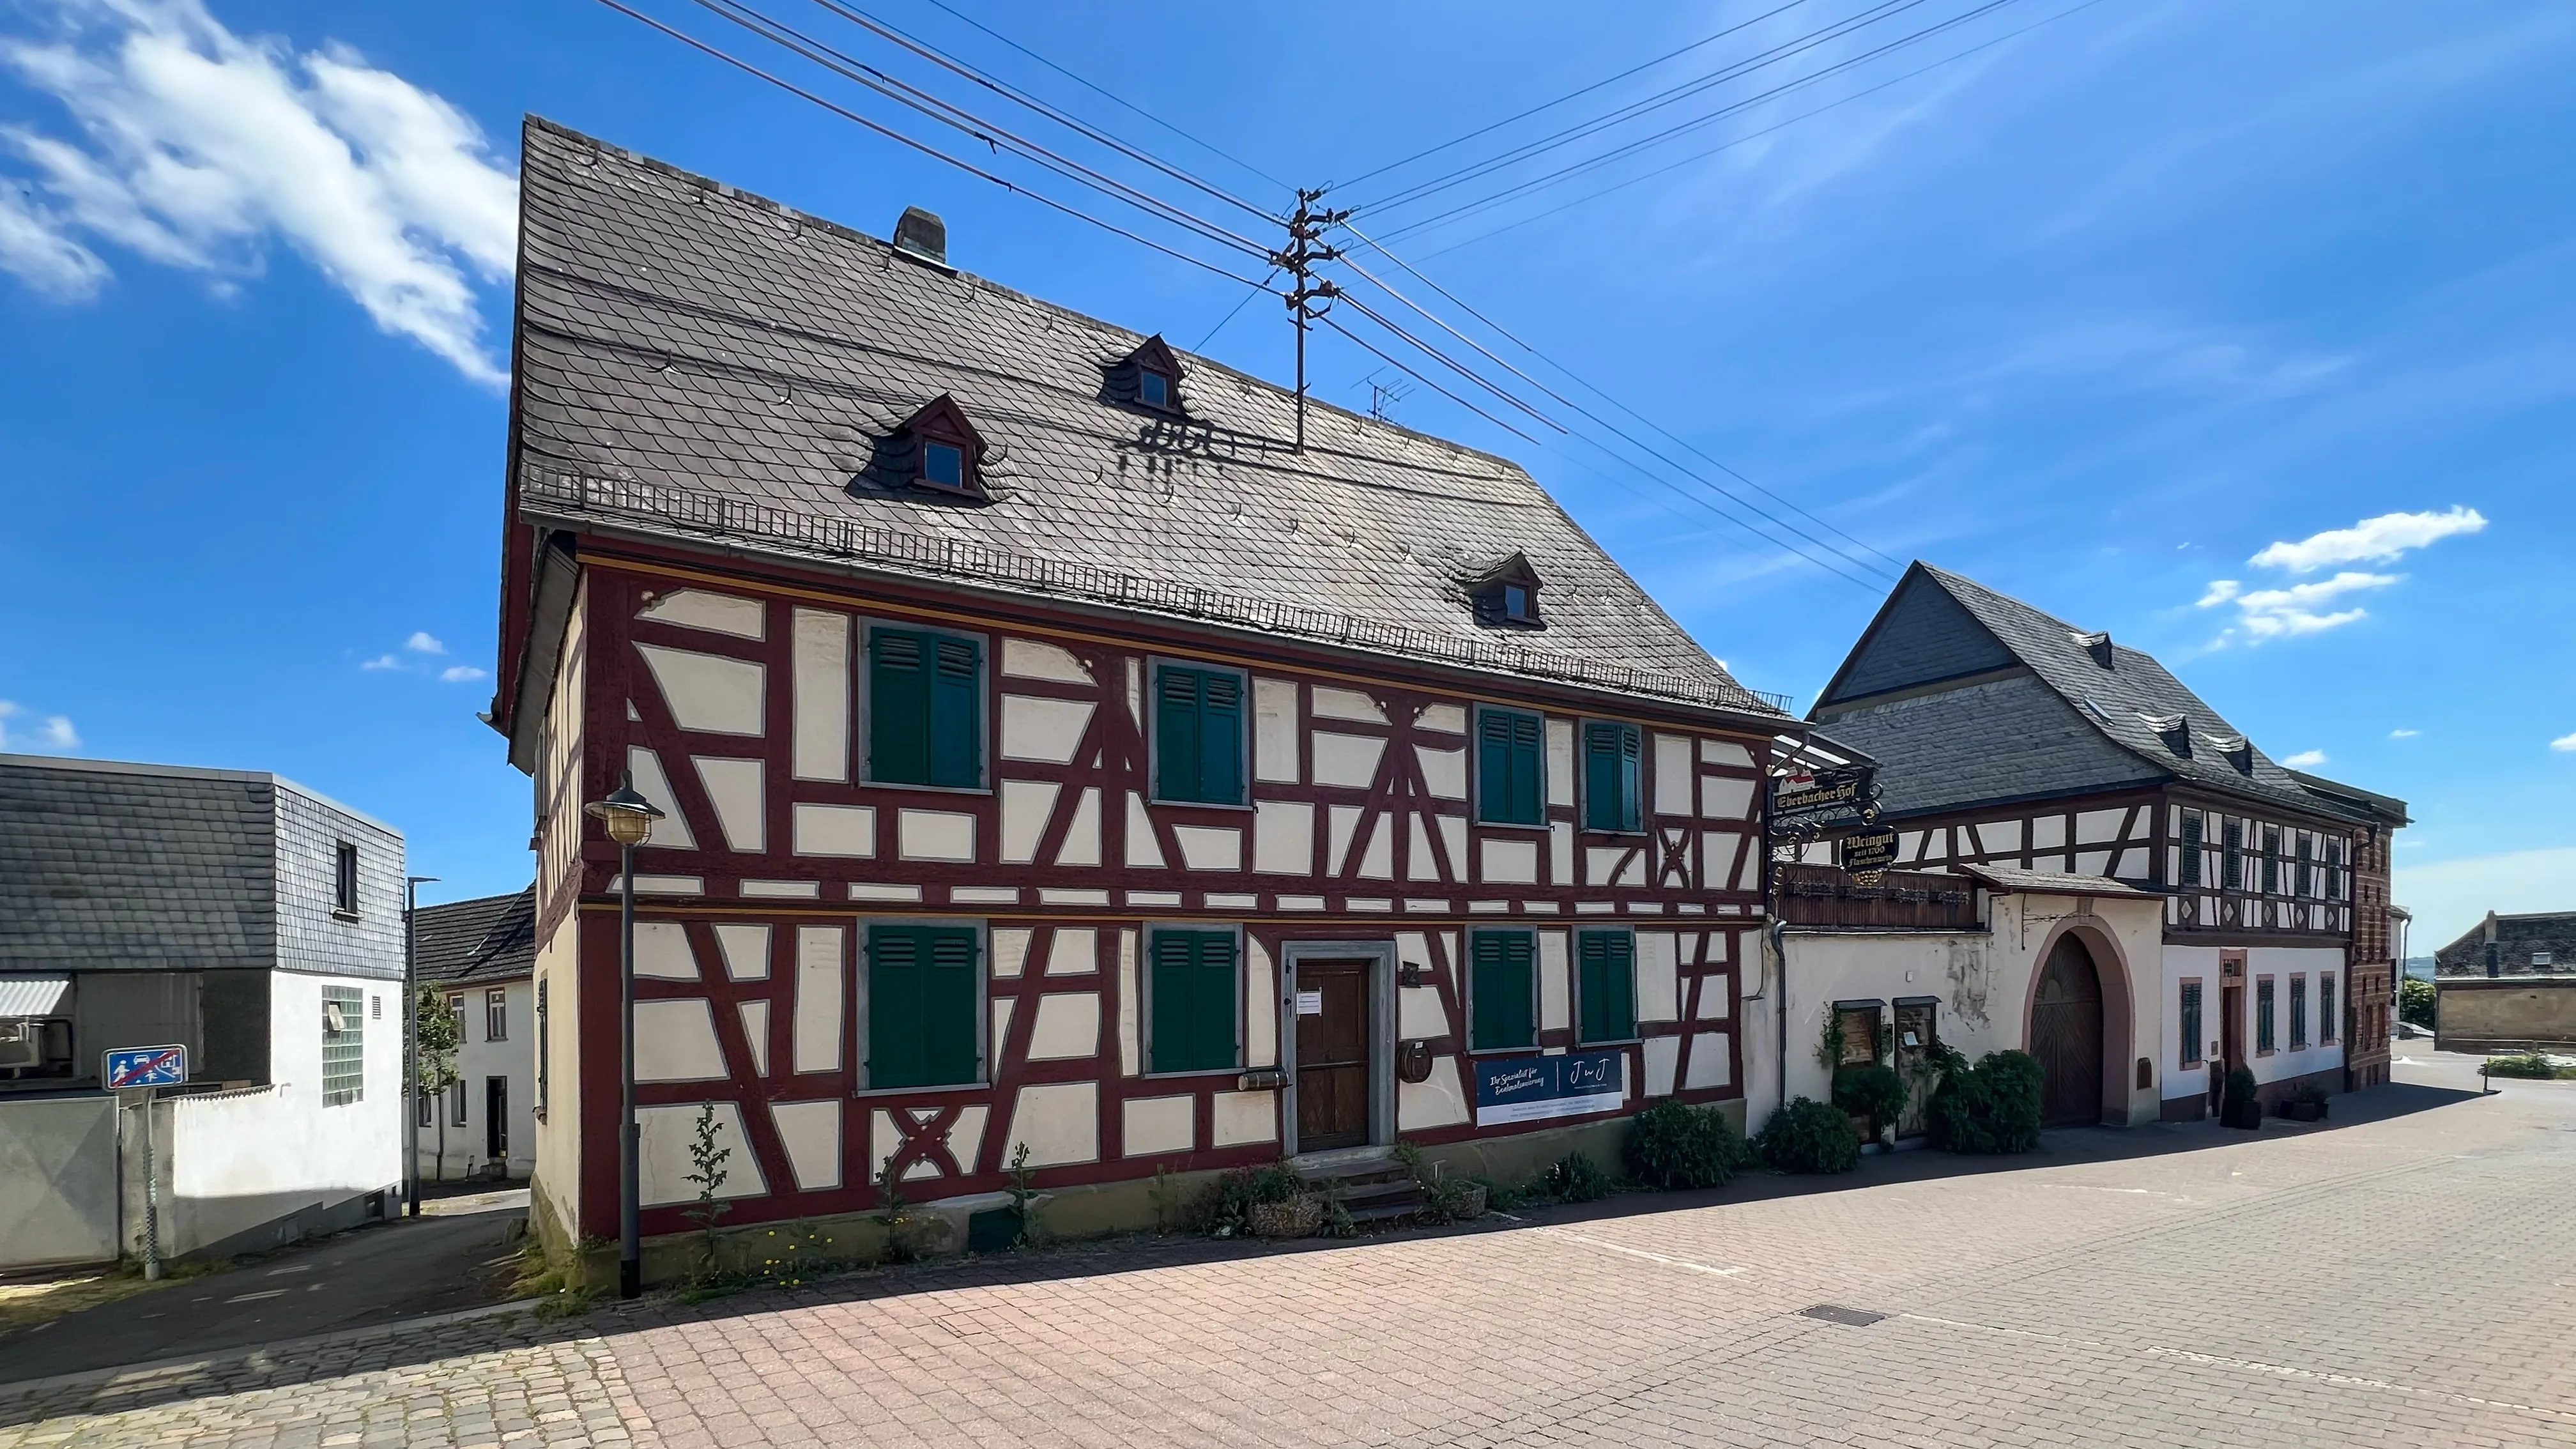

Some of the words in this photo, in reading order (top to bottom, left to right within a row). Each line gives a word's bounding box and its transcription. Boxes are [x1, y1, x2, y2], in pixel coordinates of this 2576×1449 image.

[1777, 790, 1836, 808] Eberbacher
[1836, 782, 1859, 799] Hof
[1846, 832, 1894, 849] Weingut
[1854, 849, 1867, 857] seit
[1868, 846, 1885, 855] 1700
